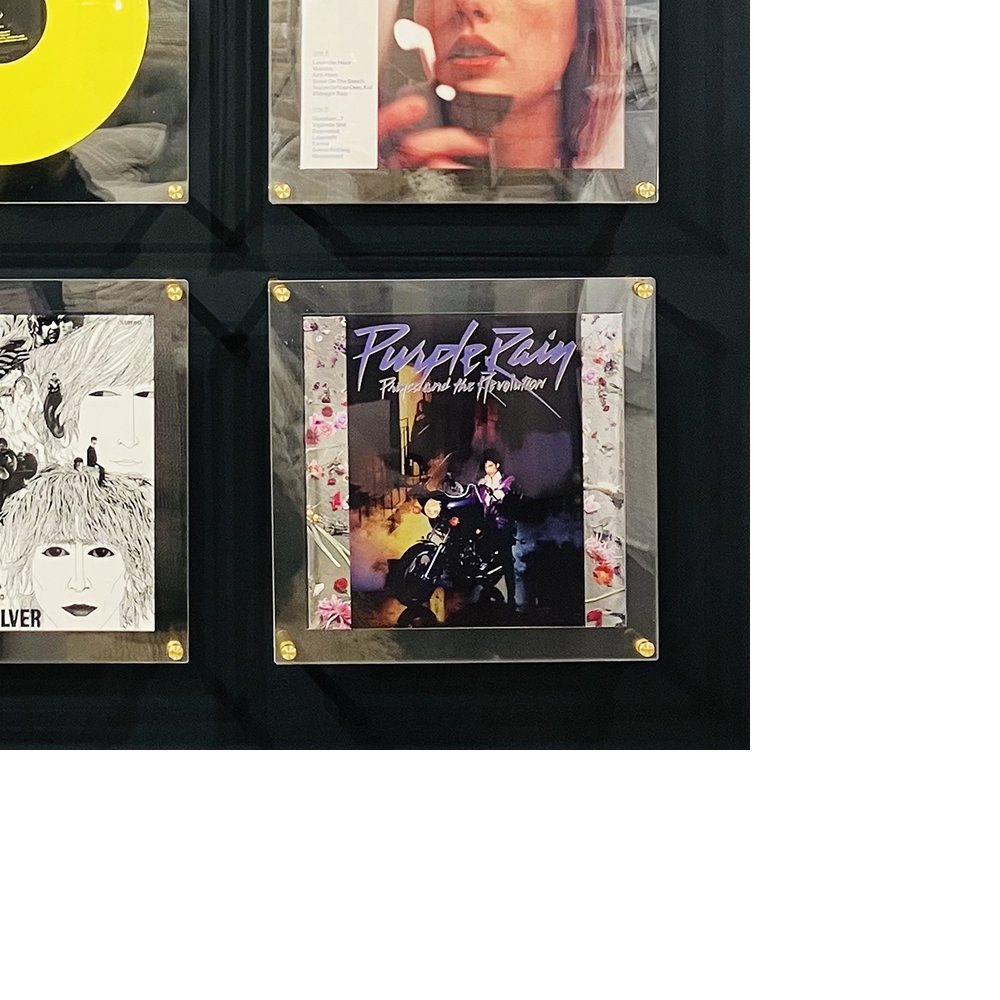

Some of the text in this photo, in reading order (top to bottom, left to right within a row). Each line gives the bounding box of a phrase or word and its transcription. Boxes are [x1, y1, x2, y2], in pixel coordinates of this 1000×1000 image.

[353, 320, 577, 418] Purple Rain
[421, 376, 451, 393] and
[453, 377, 475, 395] the
[477, 371, 548, 407] Revolution
